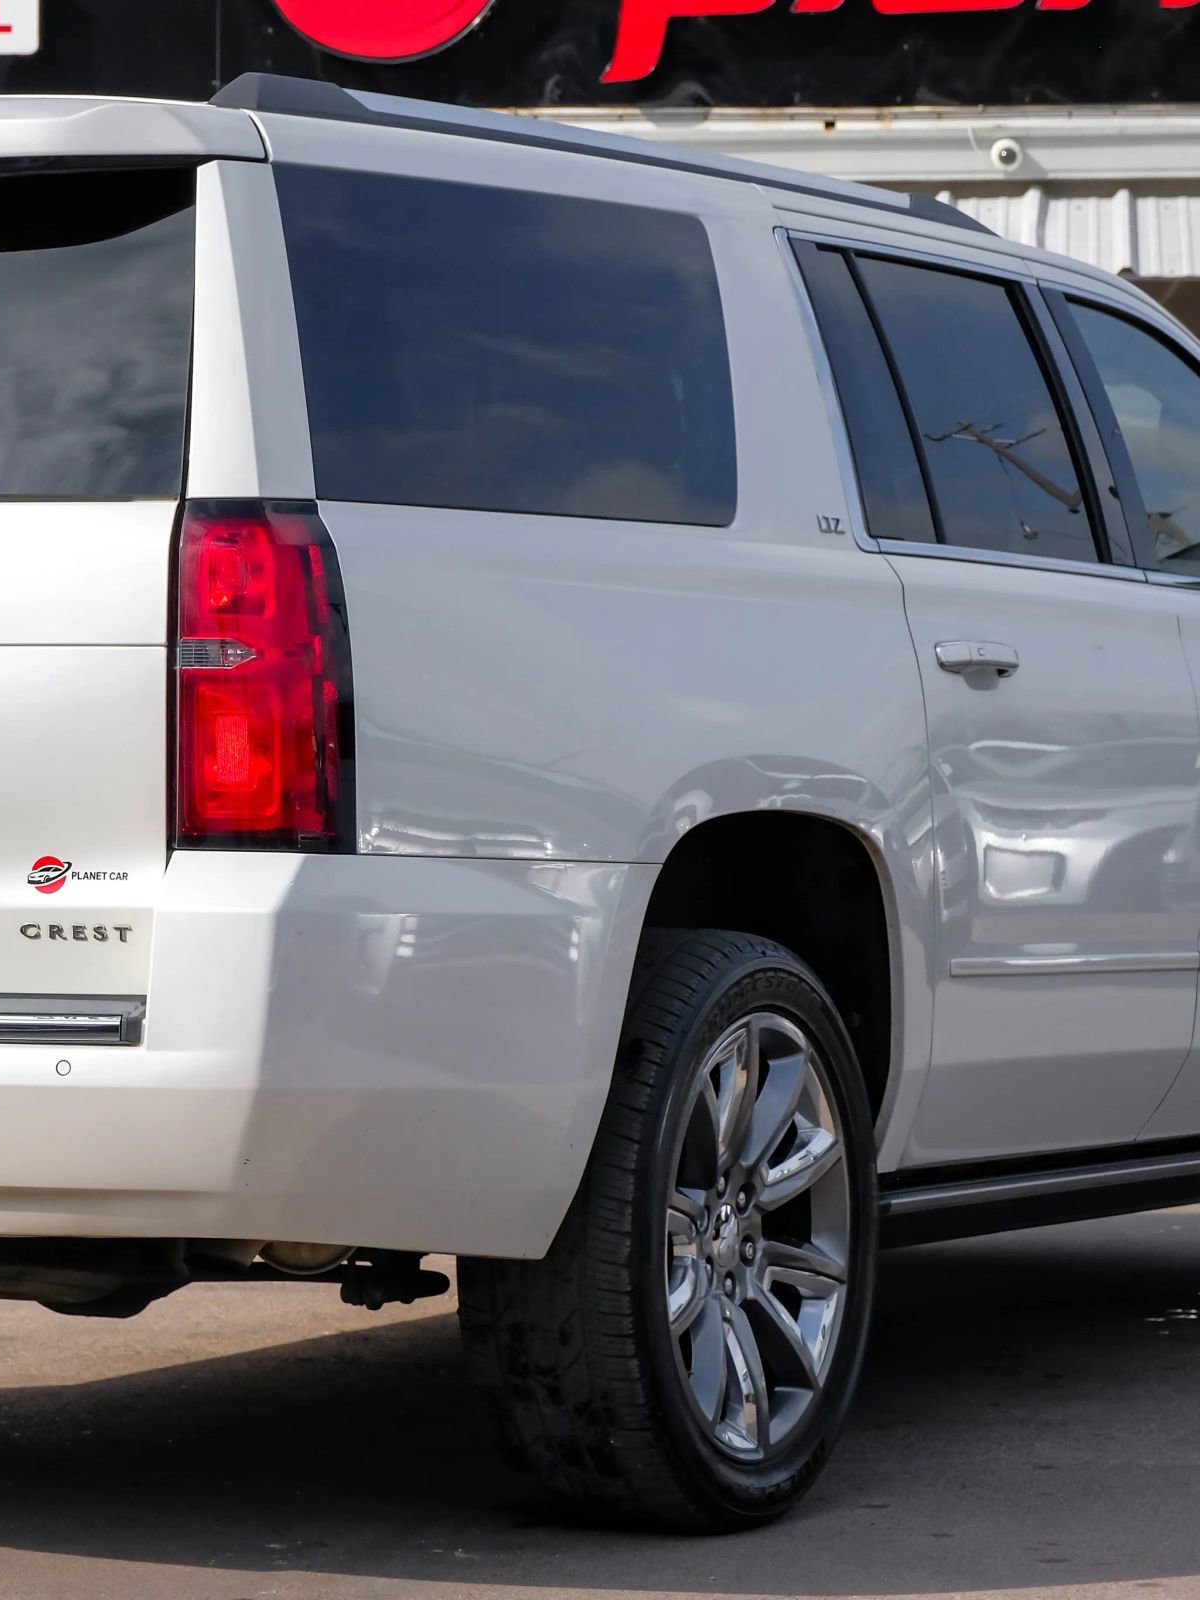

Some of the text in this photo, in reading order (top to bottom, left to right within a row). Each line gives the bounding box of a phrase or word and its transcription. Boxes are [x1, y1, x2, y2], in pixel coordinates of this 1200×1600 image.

[816, 513, 847, 535] LTZ
[71, 871, 129, 881] PLANET CAR
[19, 923, 133, 943] CREST
